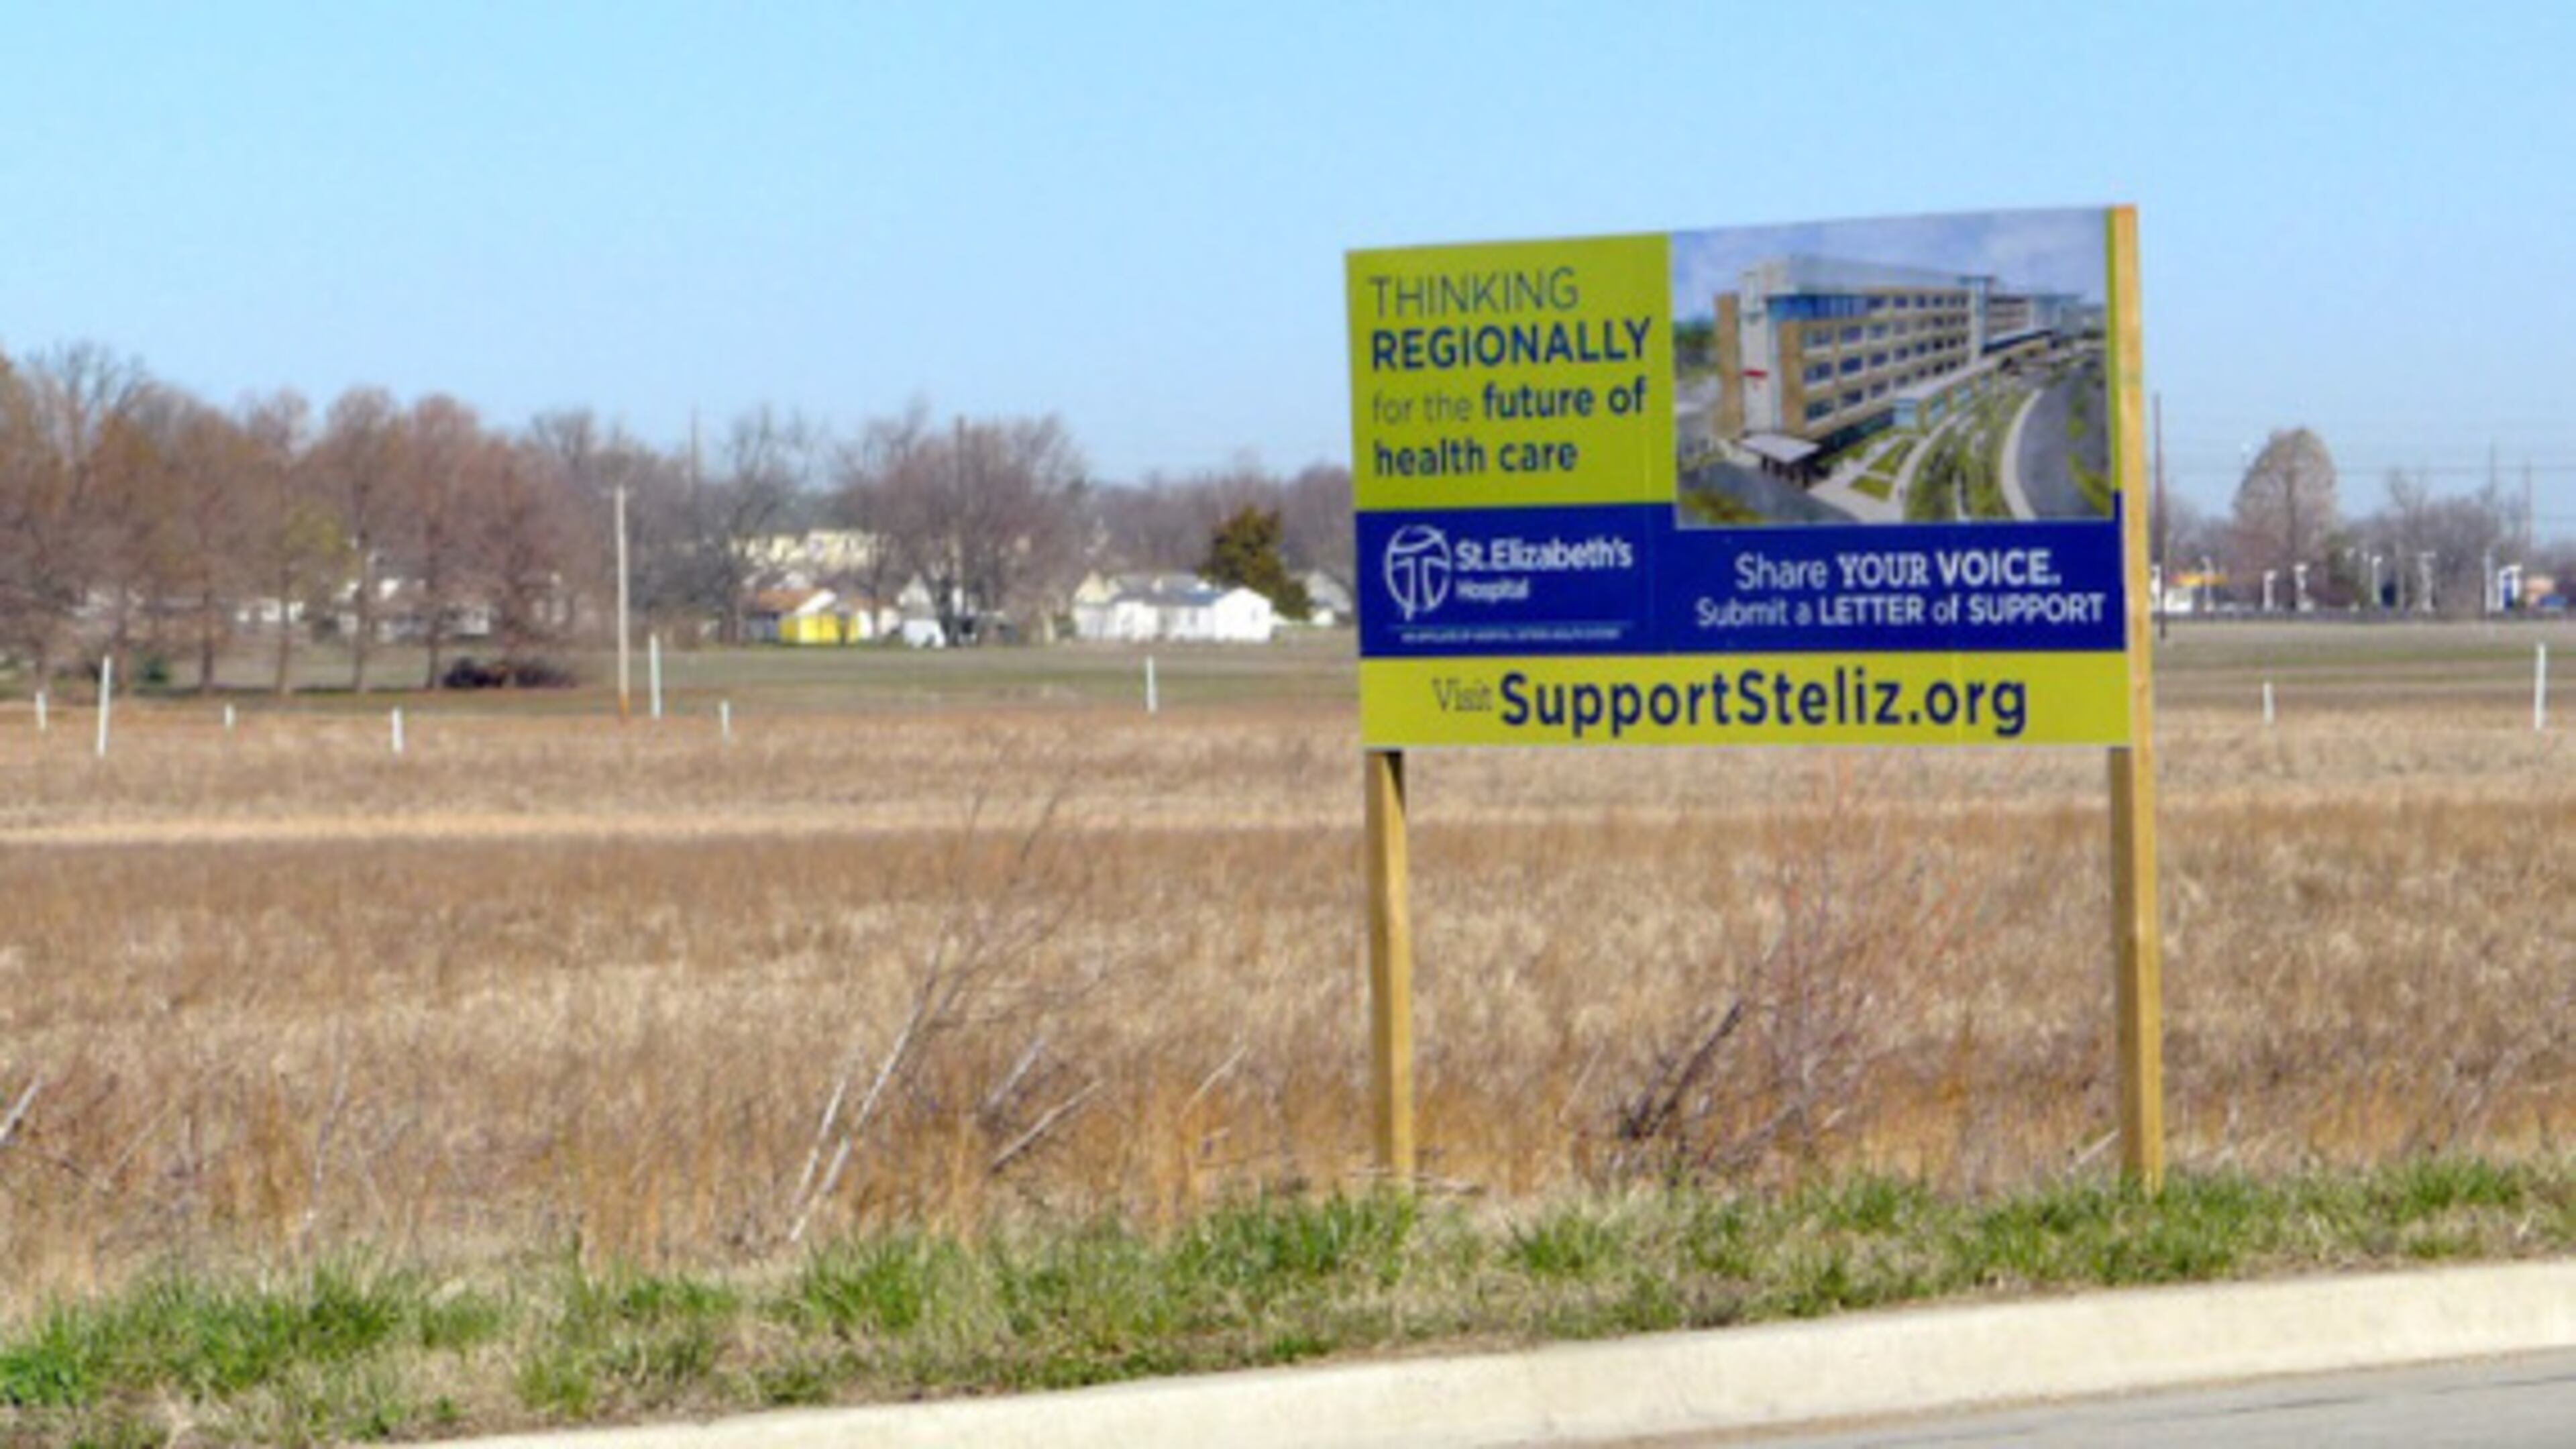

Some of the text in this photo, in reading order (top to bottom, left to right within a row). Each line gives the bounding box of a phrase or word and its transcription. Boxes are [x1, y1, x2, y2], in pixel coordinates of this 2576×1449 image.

[1369, 266, 1578, 318] THINKING
[1372, 317, 1651, 370] REGIONALLY
[1373, 376, 1647, 424] for the future of
[1374, 435, 1578, 477] health care
[1735, 549, 2061, 590] Share YOUR VOICE.
[1697, 593, 2105, 627] Submit a LETTER of SUPPORT
[1431, 667, 2026, 739] Visit SupportSteliz.org
